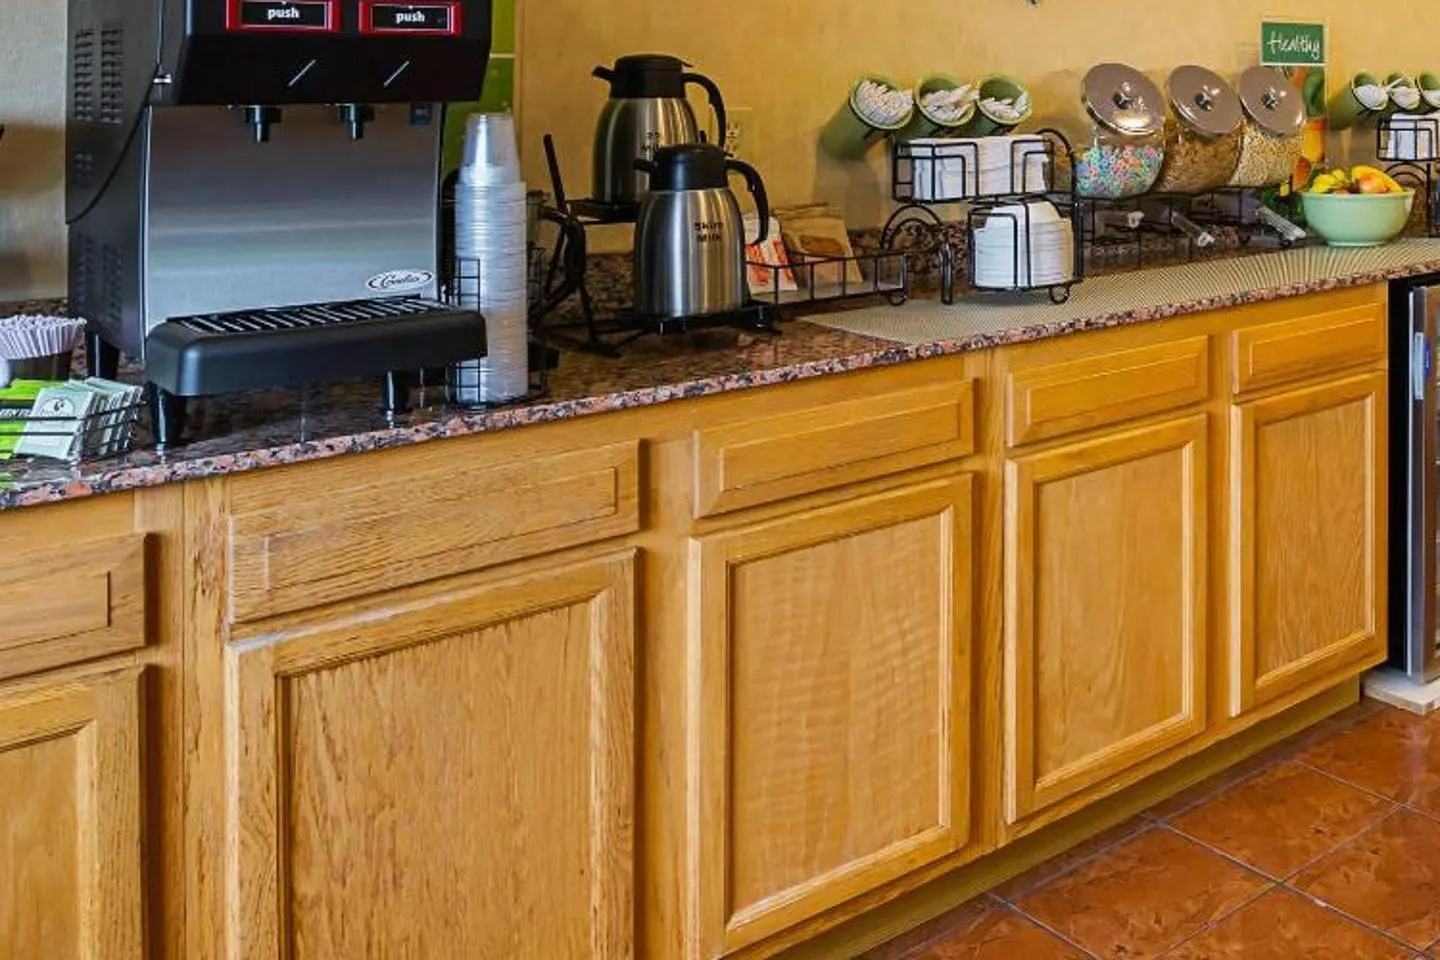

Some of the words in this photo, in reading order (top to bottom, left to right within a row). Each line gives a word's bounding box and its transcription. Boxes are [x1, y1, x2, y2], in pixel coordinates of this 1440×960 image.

[267, 6, 299, 20] push
[395, 11, 425, 24] push
[1267, 30, 1320, 61] Healthy
